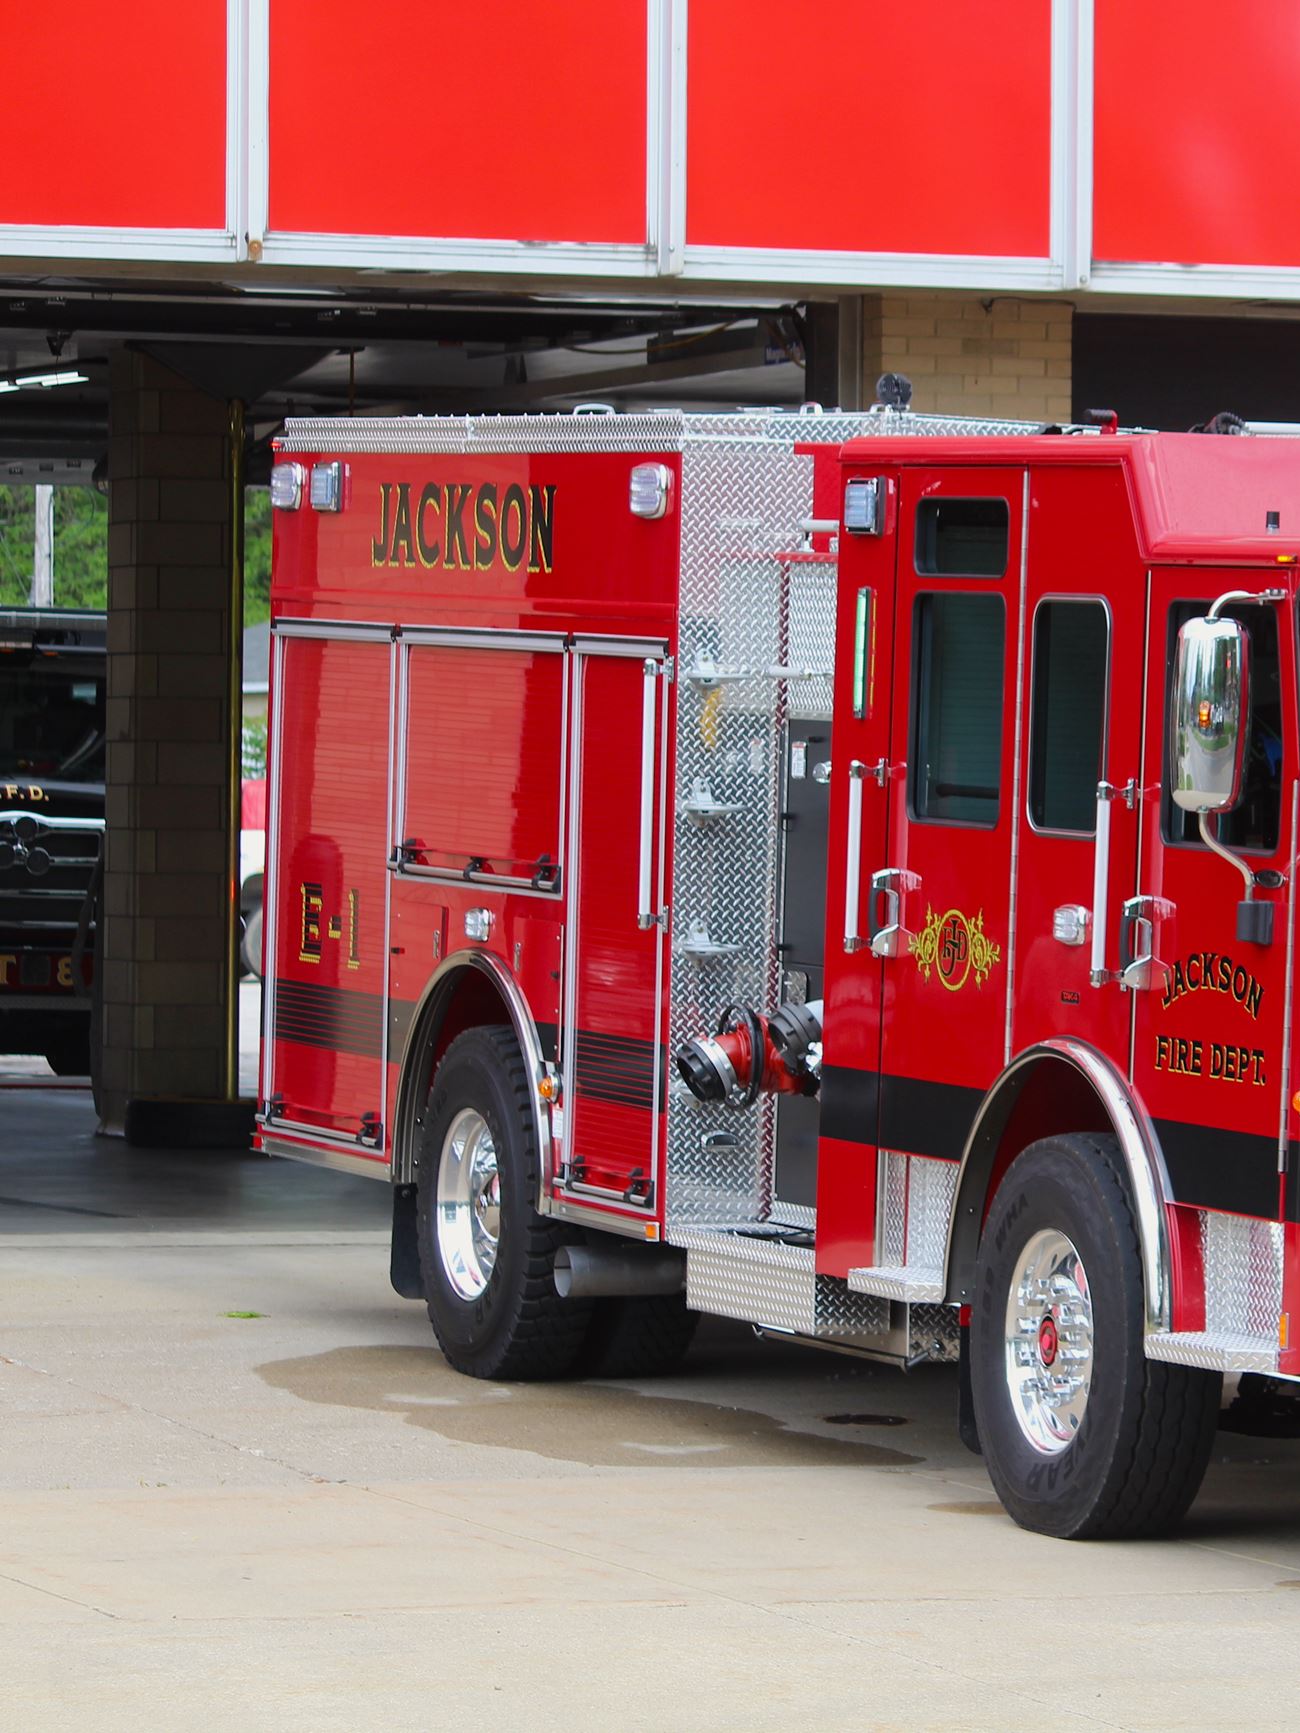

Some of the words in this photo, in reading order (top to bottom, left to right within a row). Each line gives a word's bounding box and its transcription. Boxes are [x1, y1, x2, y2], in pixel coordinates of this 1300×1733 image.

[371, 482, 557, 574] JACKSON
[1161, 952, 1265, 1020] JACKSON
[1154, 1035, 1203, 1076] FIRE
[1208, 1043, 1266, 1086] DEPT.
